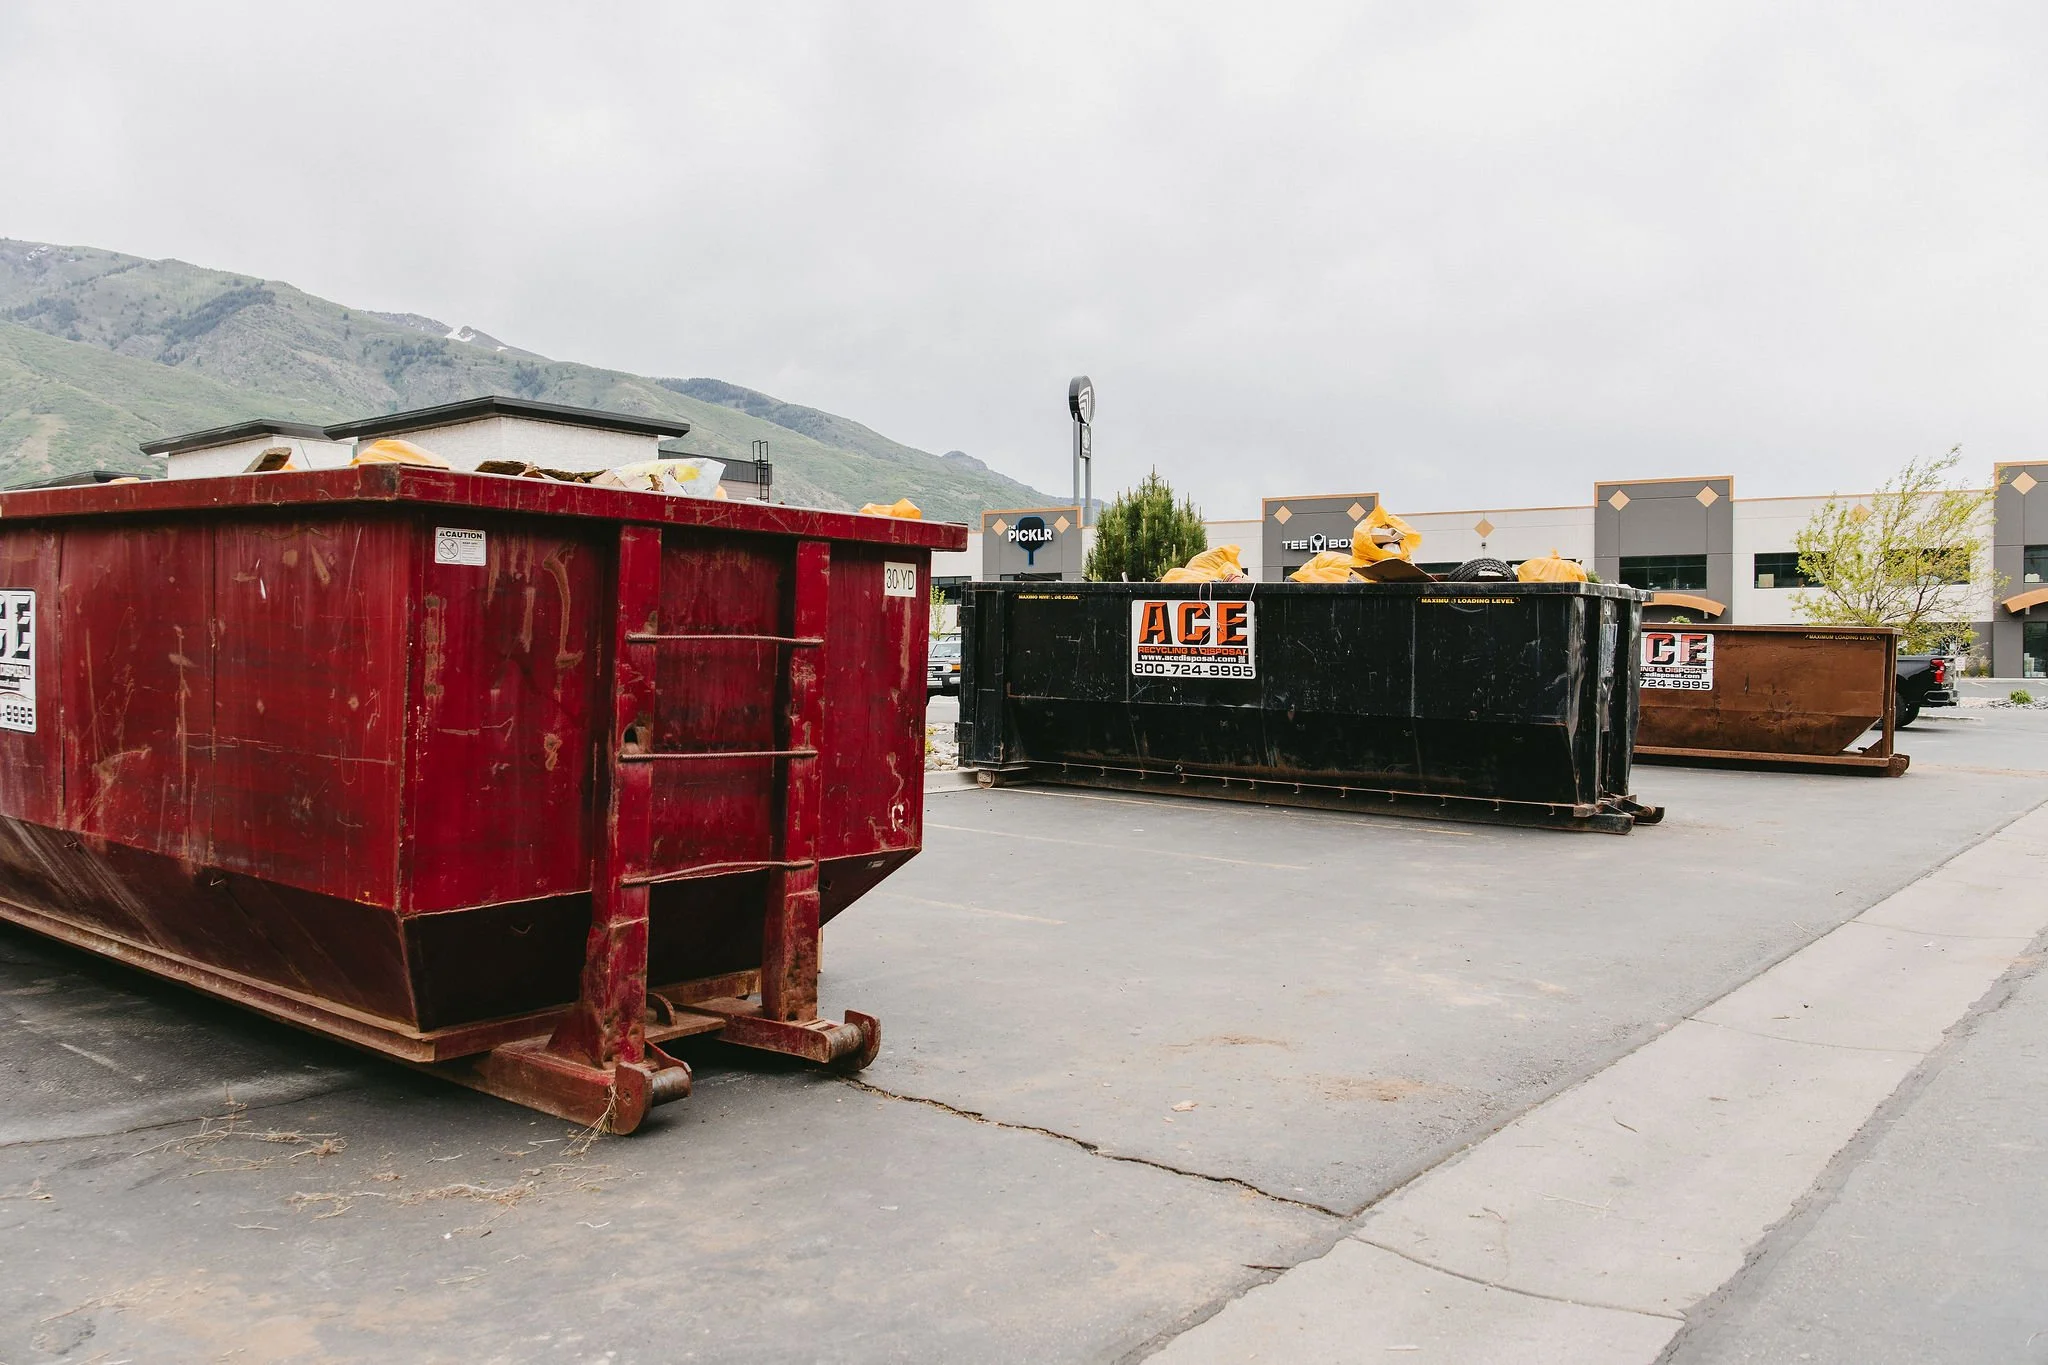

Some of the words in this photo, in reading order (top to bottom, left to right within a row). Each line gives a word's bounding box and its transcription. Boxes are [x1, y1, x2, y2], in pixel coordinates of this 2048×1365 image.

[445, 531, 483, 540] CAUTION
[1008, 528, 1053, 542] PICKLR
[1282, 540, 1308, 550] TEE
[886, 568, 898, 589] 30
[900, 569, 915, 591] YD
[1139, 602, 1247, 646] ACE
[1138, 646, 1188, 655] RECYCLING
[1200, 648, 1248, 656] DISPOSAL
[1645, 633, 1708, 666] CE
[1141, 654, 1237, 663] www.acedisposal.com
[1134, 663, 1254, 677] 800-724-9995
[1640, 679, 1711, 690] 724-9995
